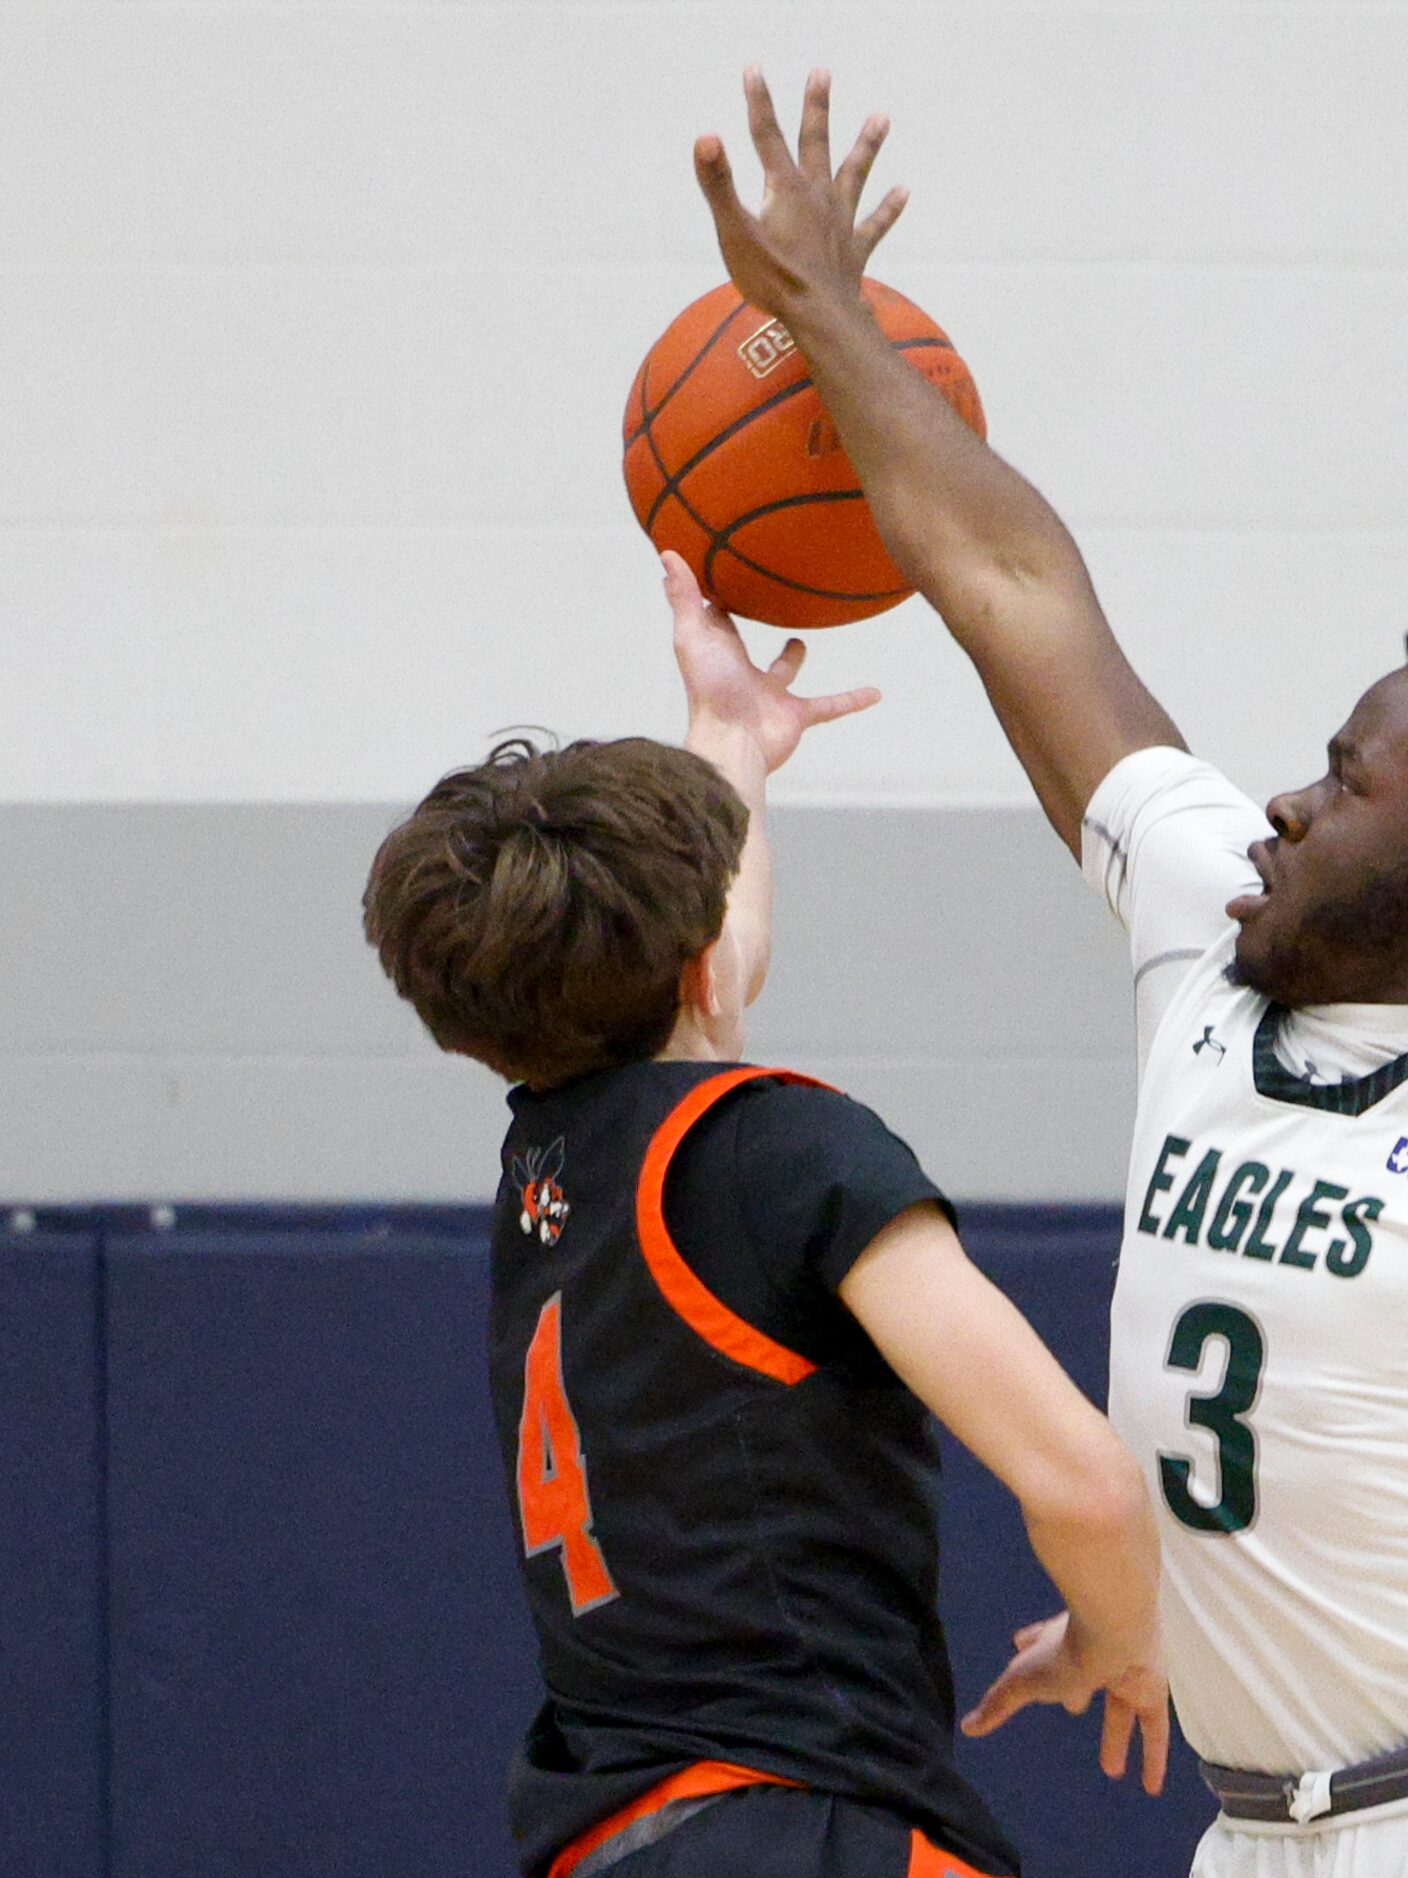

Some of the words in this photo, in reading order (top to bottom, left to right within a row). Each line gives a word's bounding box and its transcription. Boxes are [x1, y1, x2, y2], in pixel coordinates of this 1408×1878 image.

[1137, 1134, 1385, 1278] EAGLES
[517, 1290, 620, 1618] 4
[1156, 1296, 1268, 1538] 3
